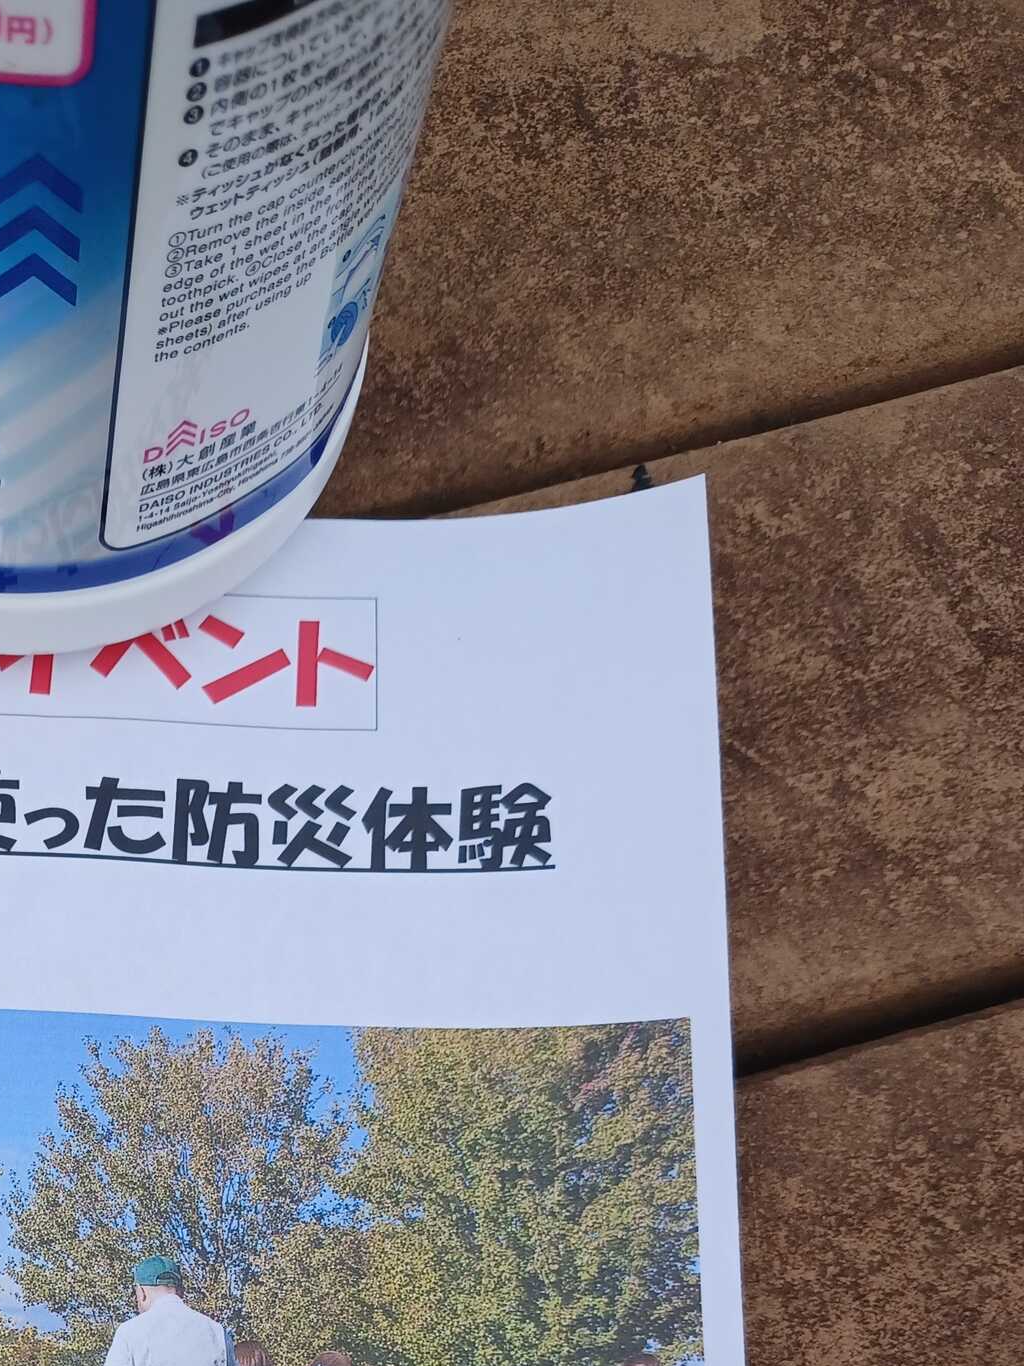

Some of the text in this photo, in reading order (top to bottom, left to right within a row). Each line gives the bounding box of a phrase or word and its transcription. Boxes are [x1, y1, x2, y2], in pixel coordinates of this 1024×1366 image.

[229, 211, 253, 228] the
[258, 196, 285, 215] cap
[244, 221, 287, 250] sheet
[292, 212, 305, 226] in
[311, 194, 331, 215] the
[256, 214, 279, 231] the
[283, 186, 325, 217] inside
[307, 224, 327, 242] the
[163, 274, 204, 293] edge
[210, 263, 225, 278] of
[230, 253, 254, 270] the
[259, 236, 285, 257] wet
[290, 216, 321, 240] wipe
[156, 272, 312, 349] sheets) after using up
[159, 306, 184, 322] out
[190, 298, 214, 313] the
[219, 283, 244, 302] wet
[249, 262, 289, 288] wipes
[226, 273, 292, 315] purchase
[296, 258, 316, 275] the
[155, 322, 250, 363] the contents.
[139, 490, 185, 513] DAISO
[189, 444, 270, 495] INDUSTRIES
